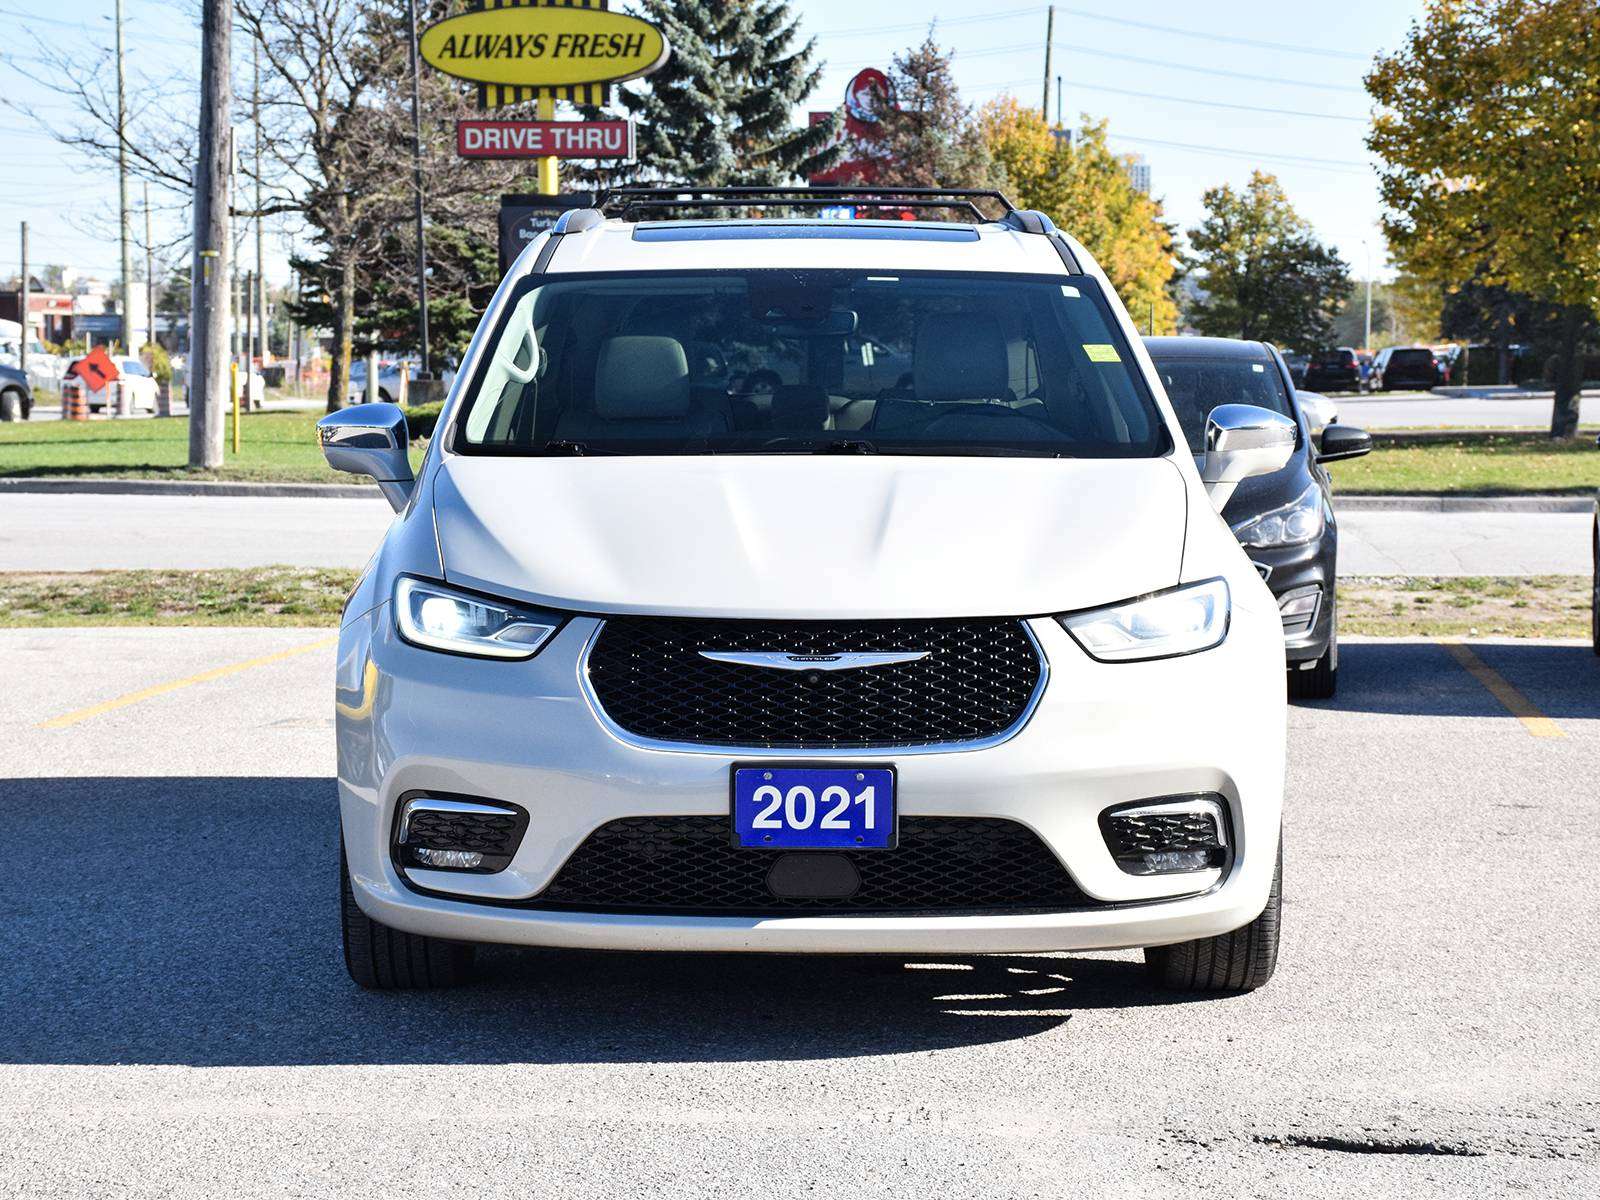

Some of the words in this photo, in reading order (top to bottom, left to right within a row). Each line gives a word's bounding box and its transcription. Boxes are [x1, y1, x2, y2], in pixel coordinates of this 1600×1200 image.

[438, 34, 548, 59] ALWAYS
[552, 34, 645, 58] FRESH
[464, 128, 542, 149] DRIVE
[550, 127, 622, 149] THRU
[752, 785, 875, 830] 2021
